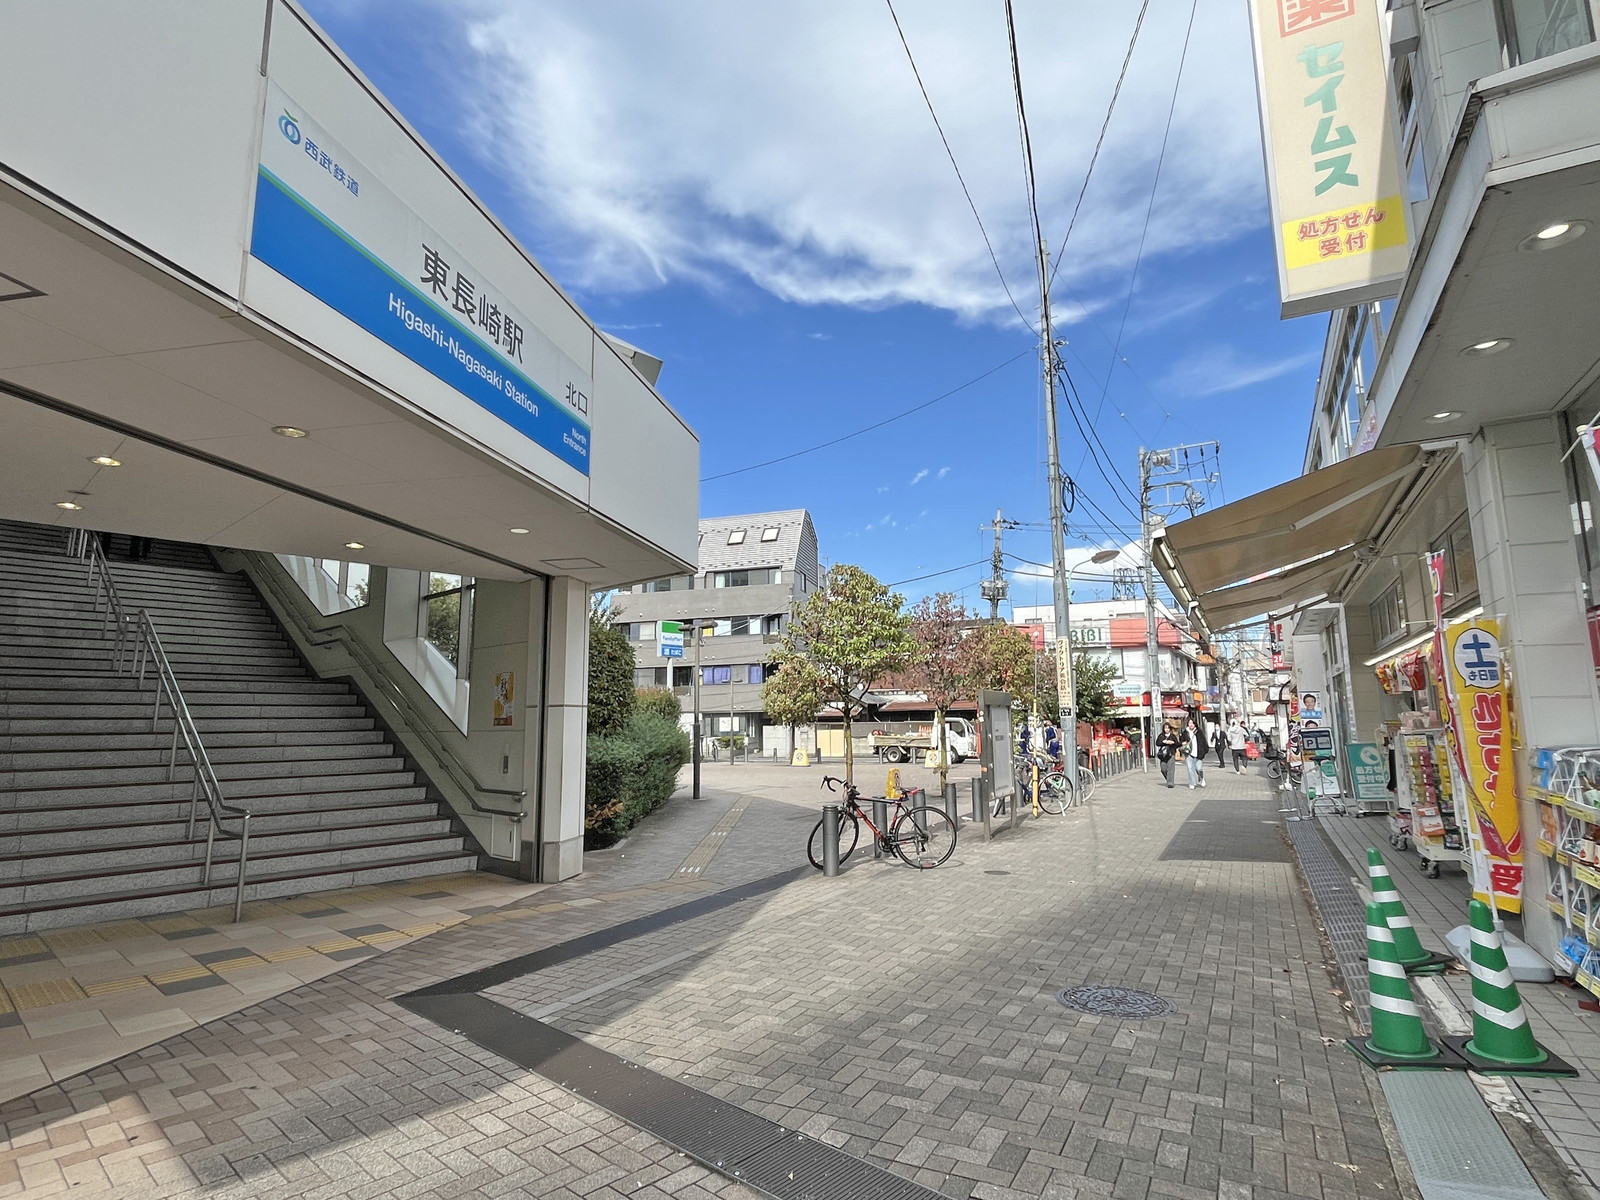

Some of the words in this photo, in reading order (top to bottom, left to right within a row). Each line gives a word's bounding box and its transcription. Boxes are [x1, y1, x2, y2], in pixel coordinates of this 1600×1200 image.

[1297, 40, 1359, 197] セイムス
[304, 137, 360, 198] 西武鉄道
[1297, 206, 1386, 241] 処方せん
[1318, 230, 1369, 258] 受付
[420, 243, 524, 364] 東長崎駅
[388, 292, 503, 391] Higashi-Nagasaki
[504, 380, 539, 418] Station
[565, 381, 588, 417] 北口
[563, 432, 587, 457] Entrance
[571, 427, 587, 445] North
